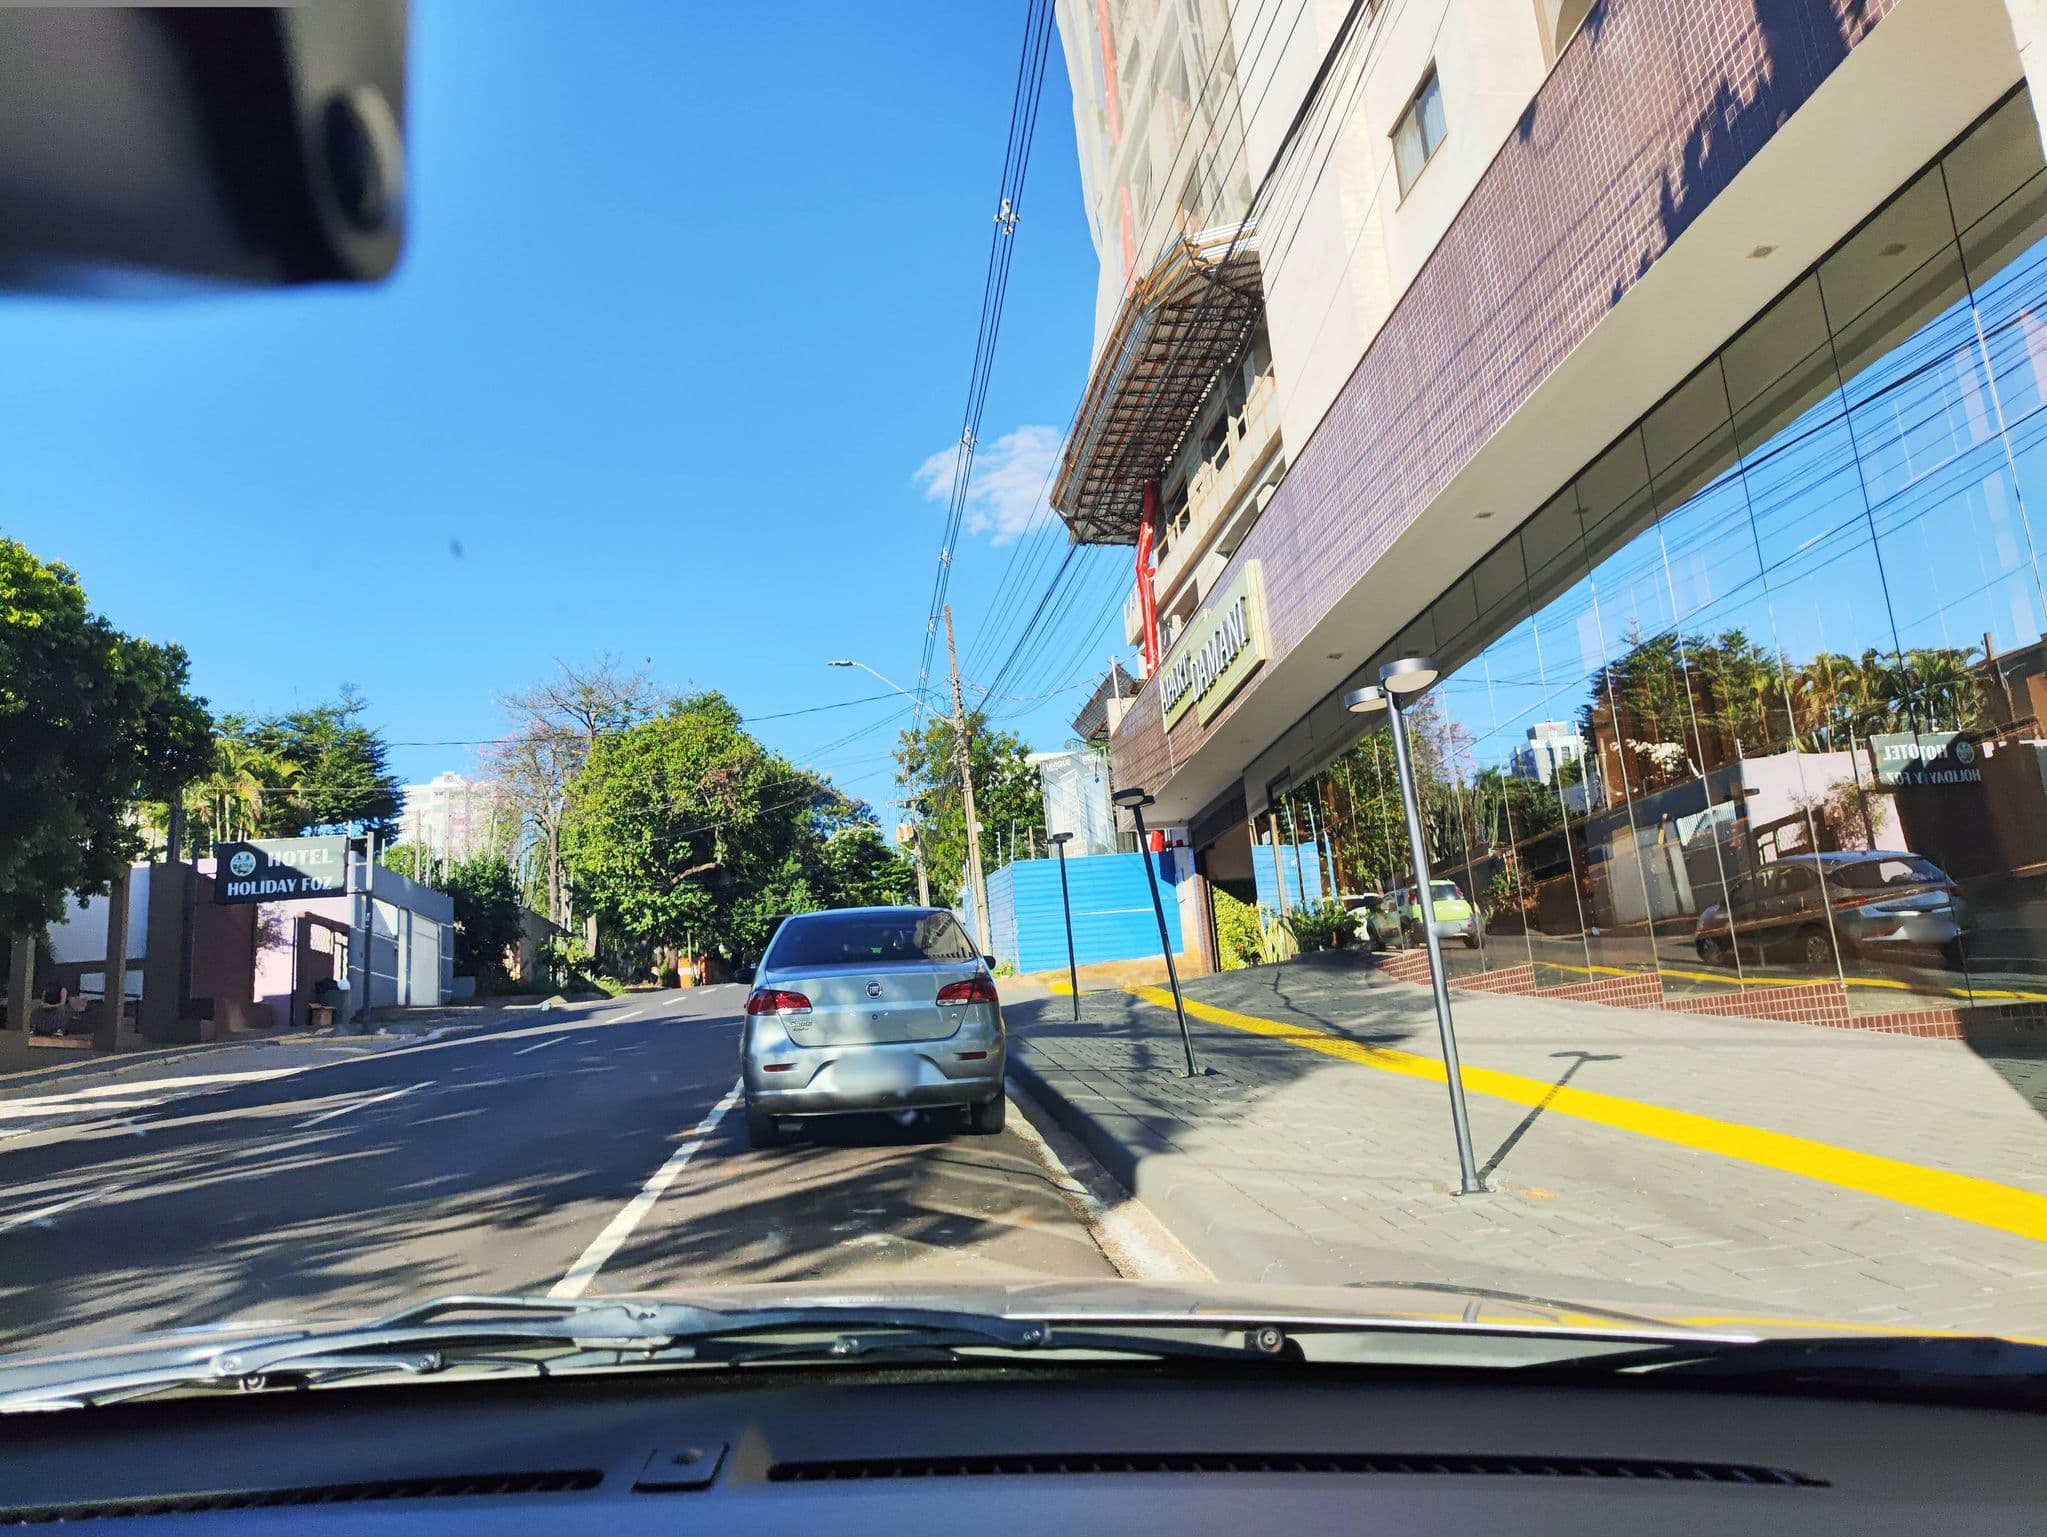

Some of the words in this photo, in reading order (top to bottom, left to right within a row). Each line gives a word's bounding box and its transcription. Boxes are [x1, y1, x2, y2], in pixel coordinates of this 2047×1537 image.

[1190, 596, 1250, 702] DAMANI
[267, 848, 333, 867] HOTEL
[227, 878, 297, 896] HOLIDAY
[301, 876, 333, 892] FOZ
